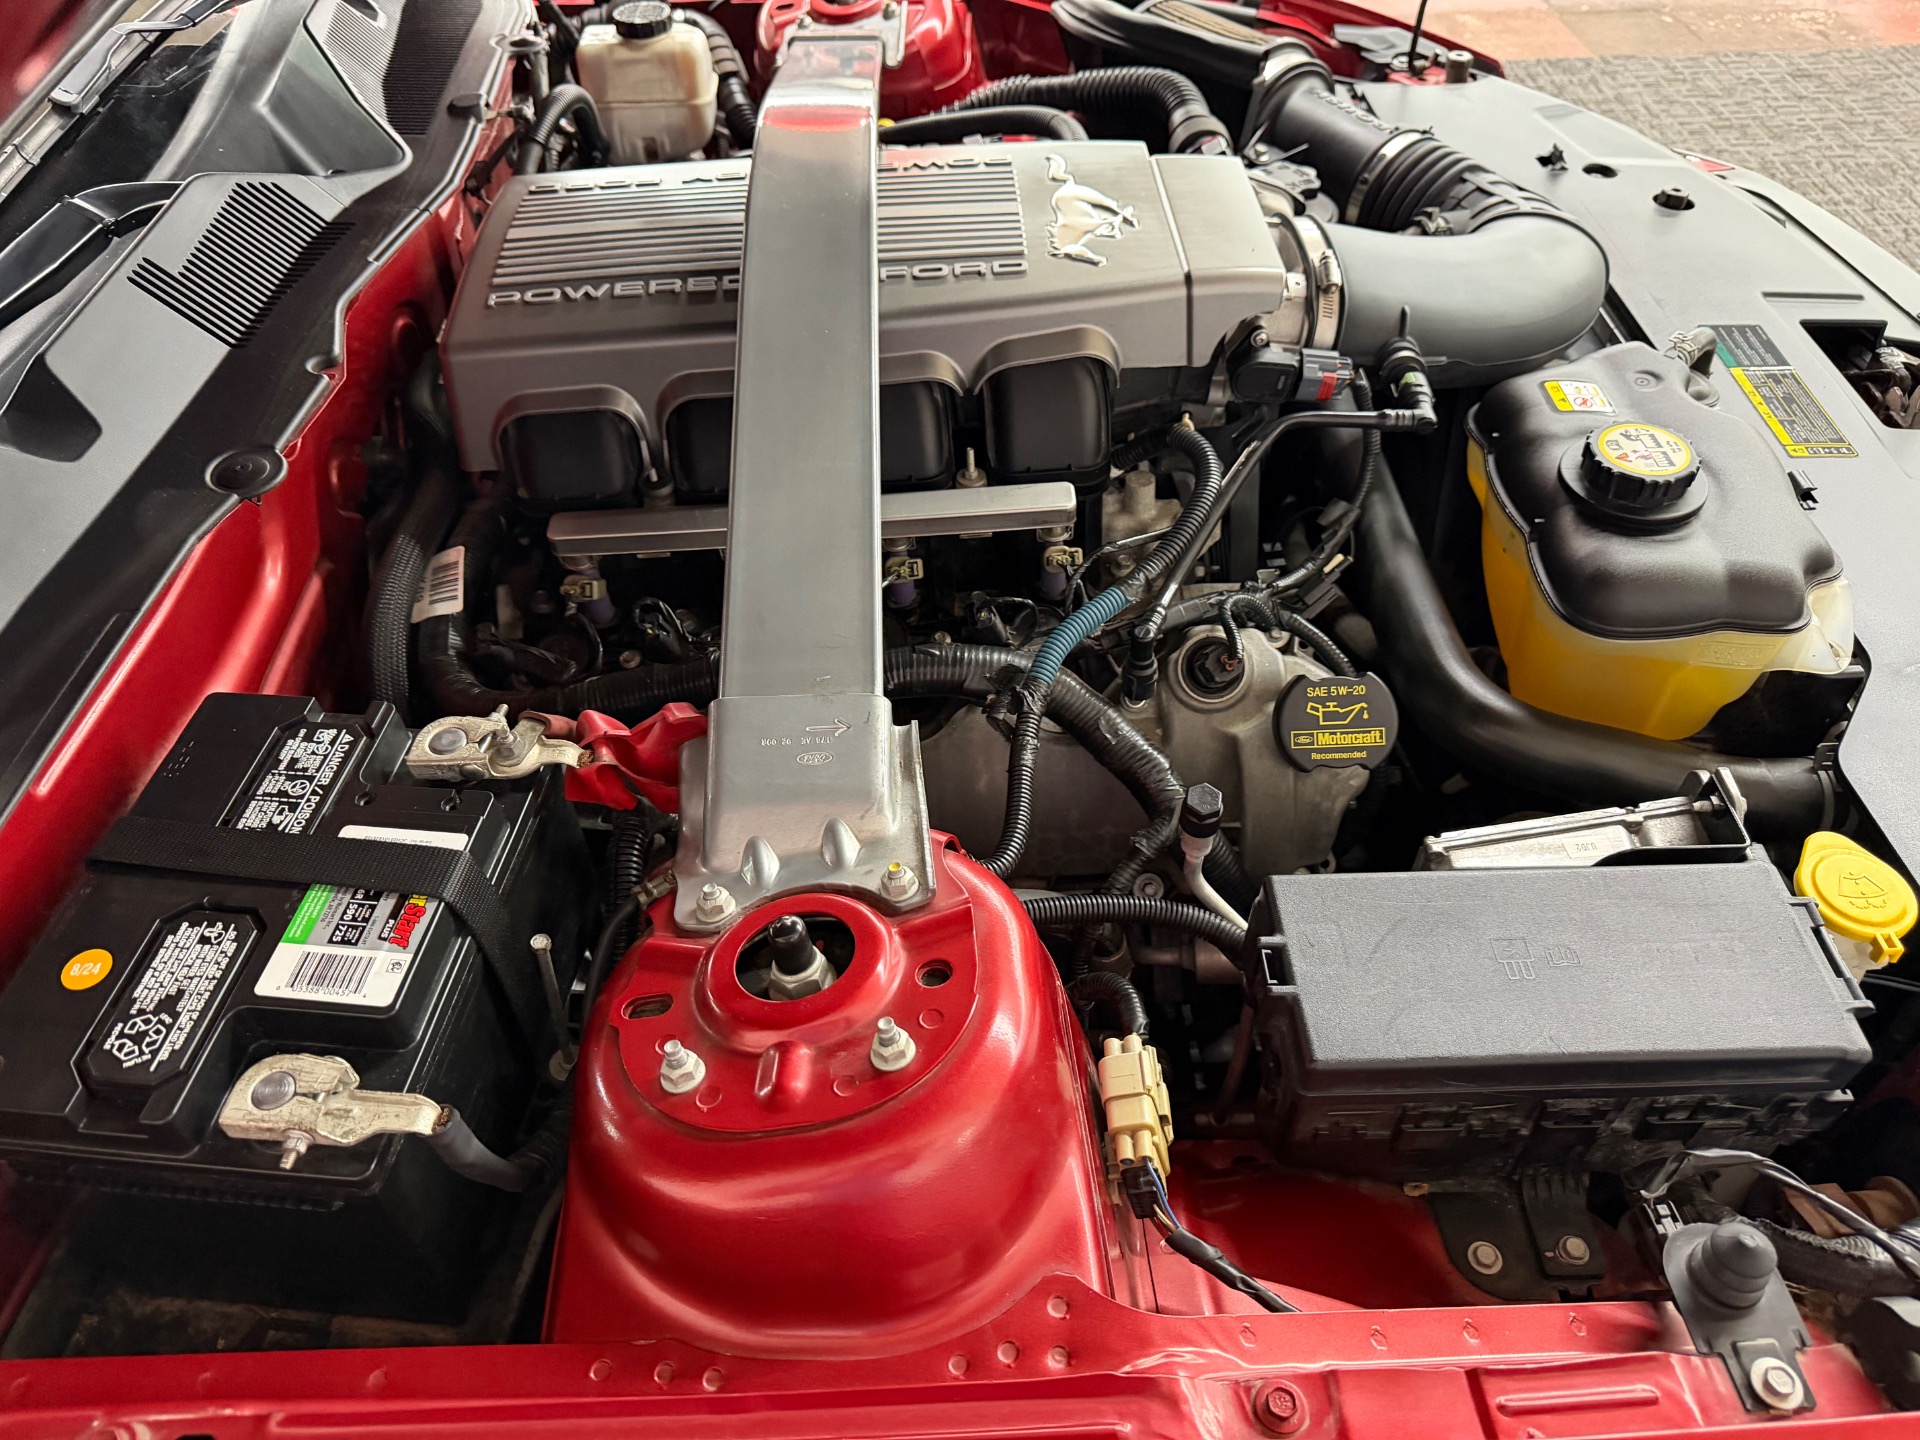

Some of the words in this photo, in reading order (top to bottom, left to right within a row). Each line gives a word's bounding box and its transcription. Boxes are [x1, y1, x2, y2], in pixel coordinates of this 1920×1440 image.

[879, 260, 1028, 281] FORD
[1306, 686, 1328, 697] SAE
[1330, 685, 1366, 696] 5W-20
[1317, 731, 1382, 745] Motorcraft
[1311, 751, 1366, 760] Recommended
[317, 745, 349, 785] DANGER
[289, 796, 320, 834] POISON
[355, 890, 365, 899] 6R
[344, 904, 358, 920] 590
[333, 926, 347, 941] 725
[381, 920, 394, 938] PLUS
[221, 940, 232, 951] NOT
[70, 962, 102, 977] 8/24
[219, 958, 229, 969] OUT
[206, 980, 217, 990] THE
[291, 985, 320, 994] 05388
[323, 987, 352, 997] 00457
[170, 1030, 181, 1042] AND
